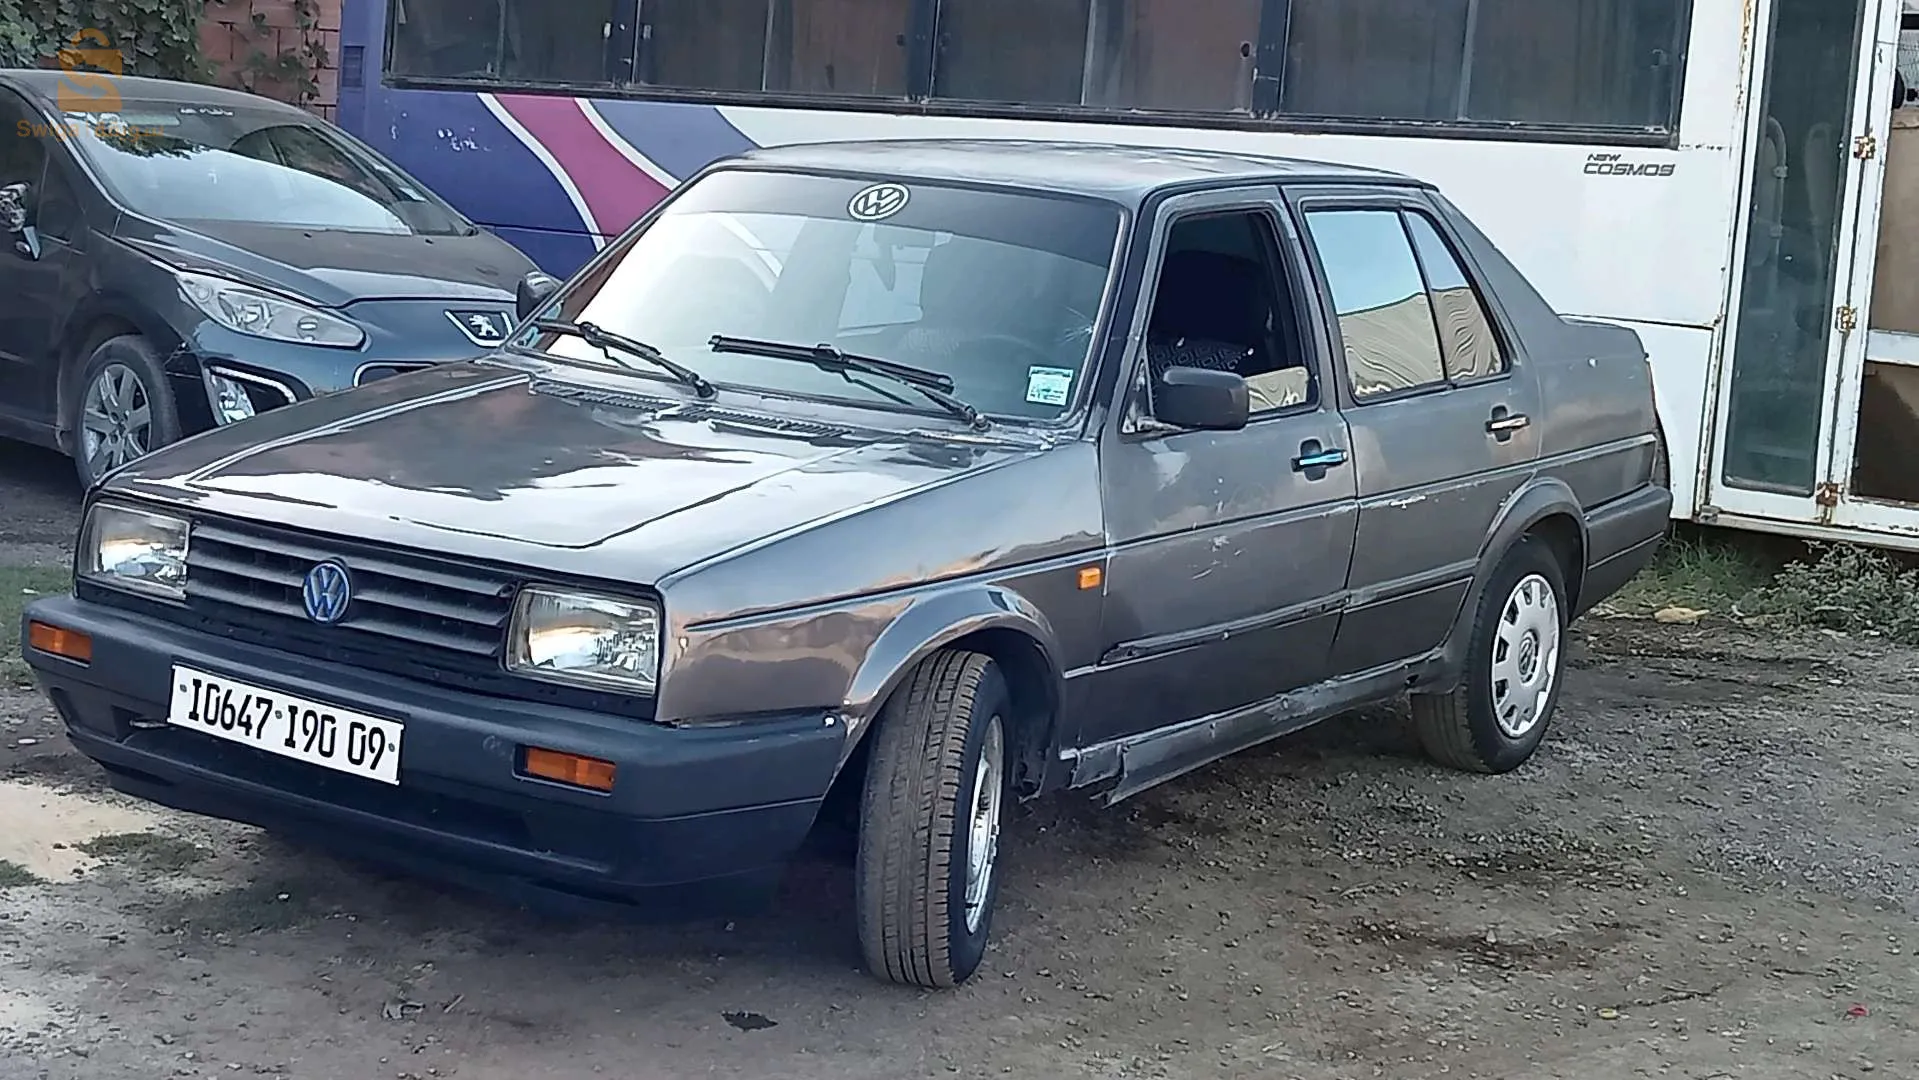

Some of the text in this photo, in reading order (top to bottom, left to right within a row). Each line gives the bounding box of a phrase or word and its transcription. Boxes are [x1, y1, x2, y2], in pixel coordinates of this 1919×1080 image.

[1583, 162, 1676, 177] COSMOS
[188, 678, 386, 770] 10647 190 09
